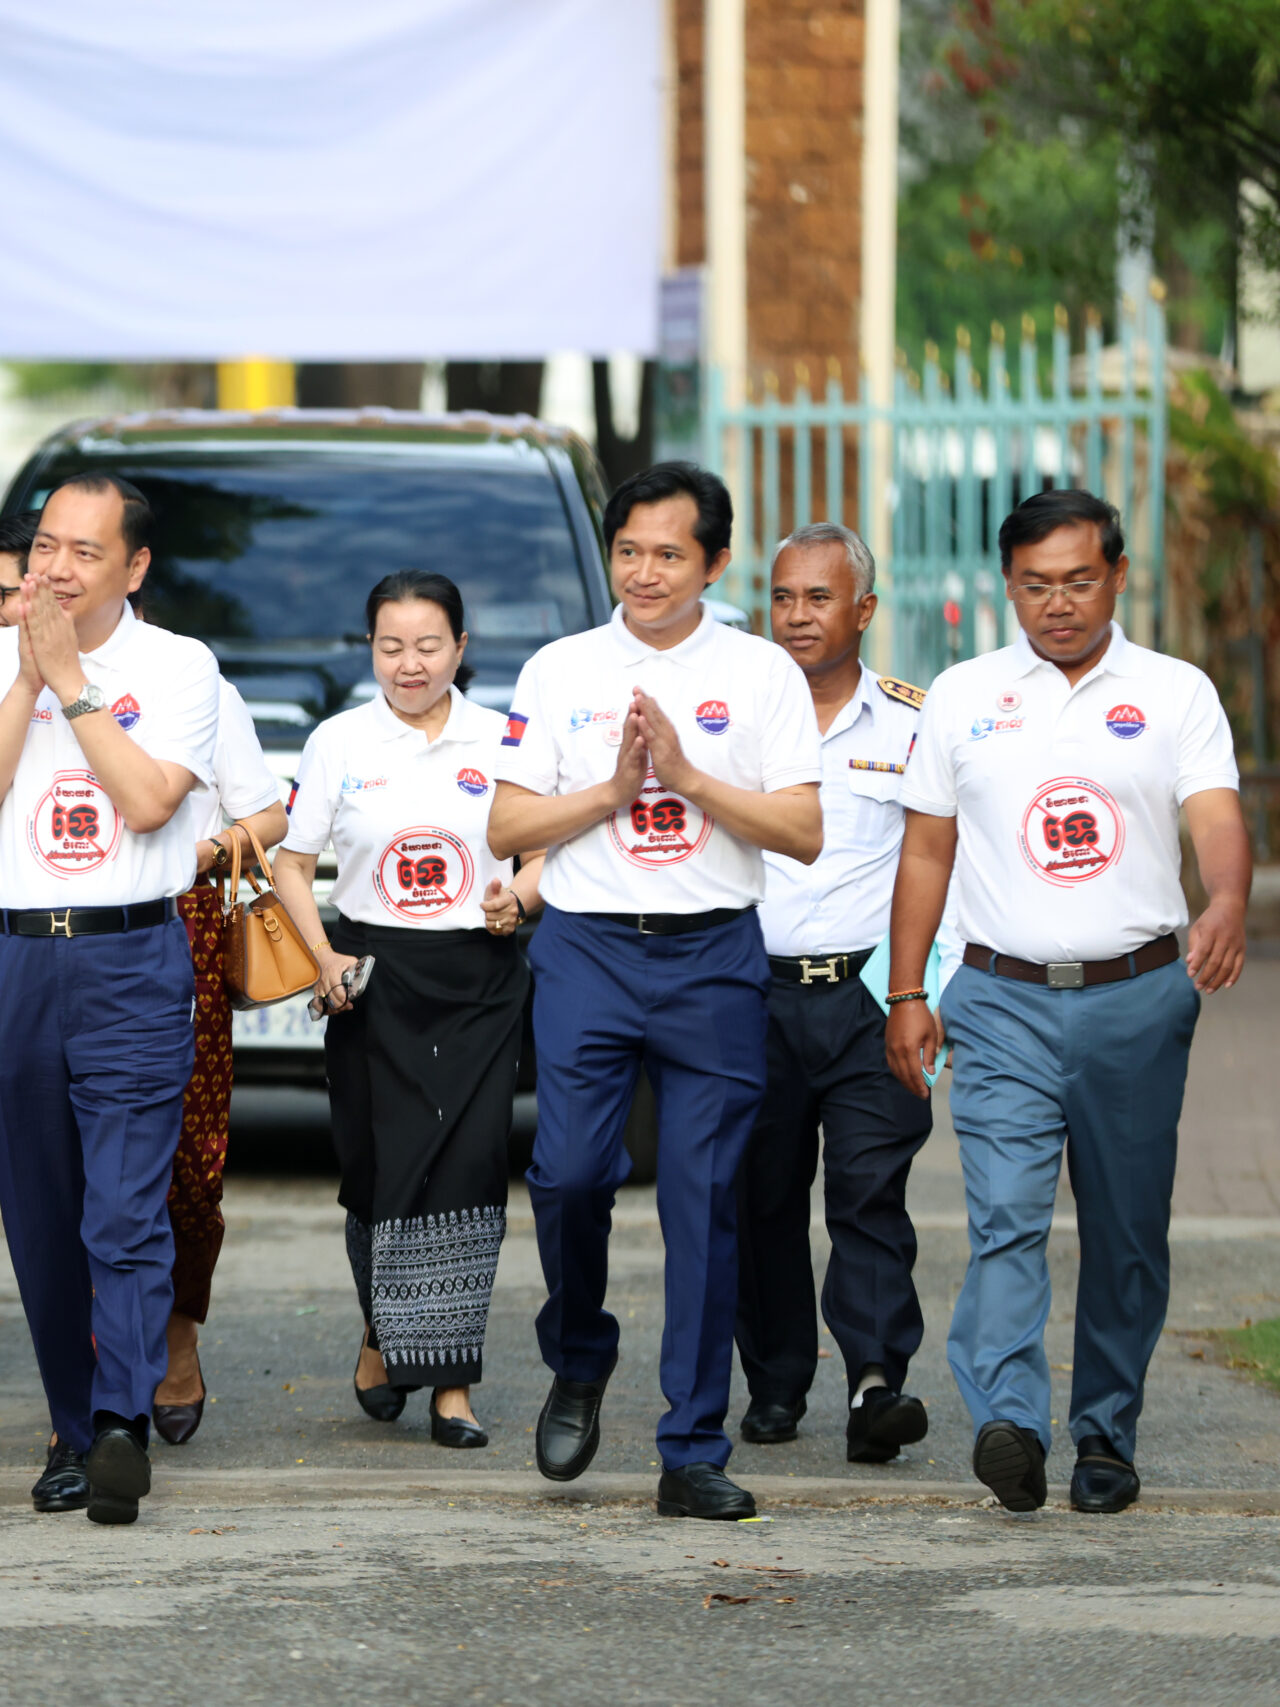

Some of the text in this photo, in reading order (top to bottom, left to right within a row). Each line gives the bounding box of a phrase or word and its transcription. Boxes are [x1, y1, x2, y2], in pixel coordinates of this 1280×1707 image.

[55, 786, 95, 798] និយាយថា
[51, 803, 100, 841] ទេ
[631, 797, 687, 836] ទេ
[1042, 810, 1100, 851] ទេ
[62, 839, 90, 850] ចំពោះ
[400, 842, 443, 852] និយាយថា
[397, 854, 448, 891] ទេ
